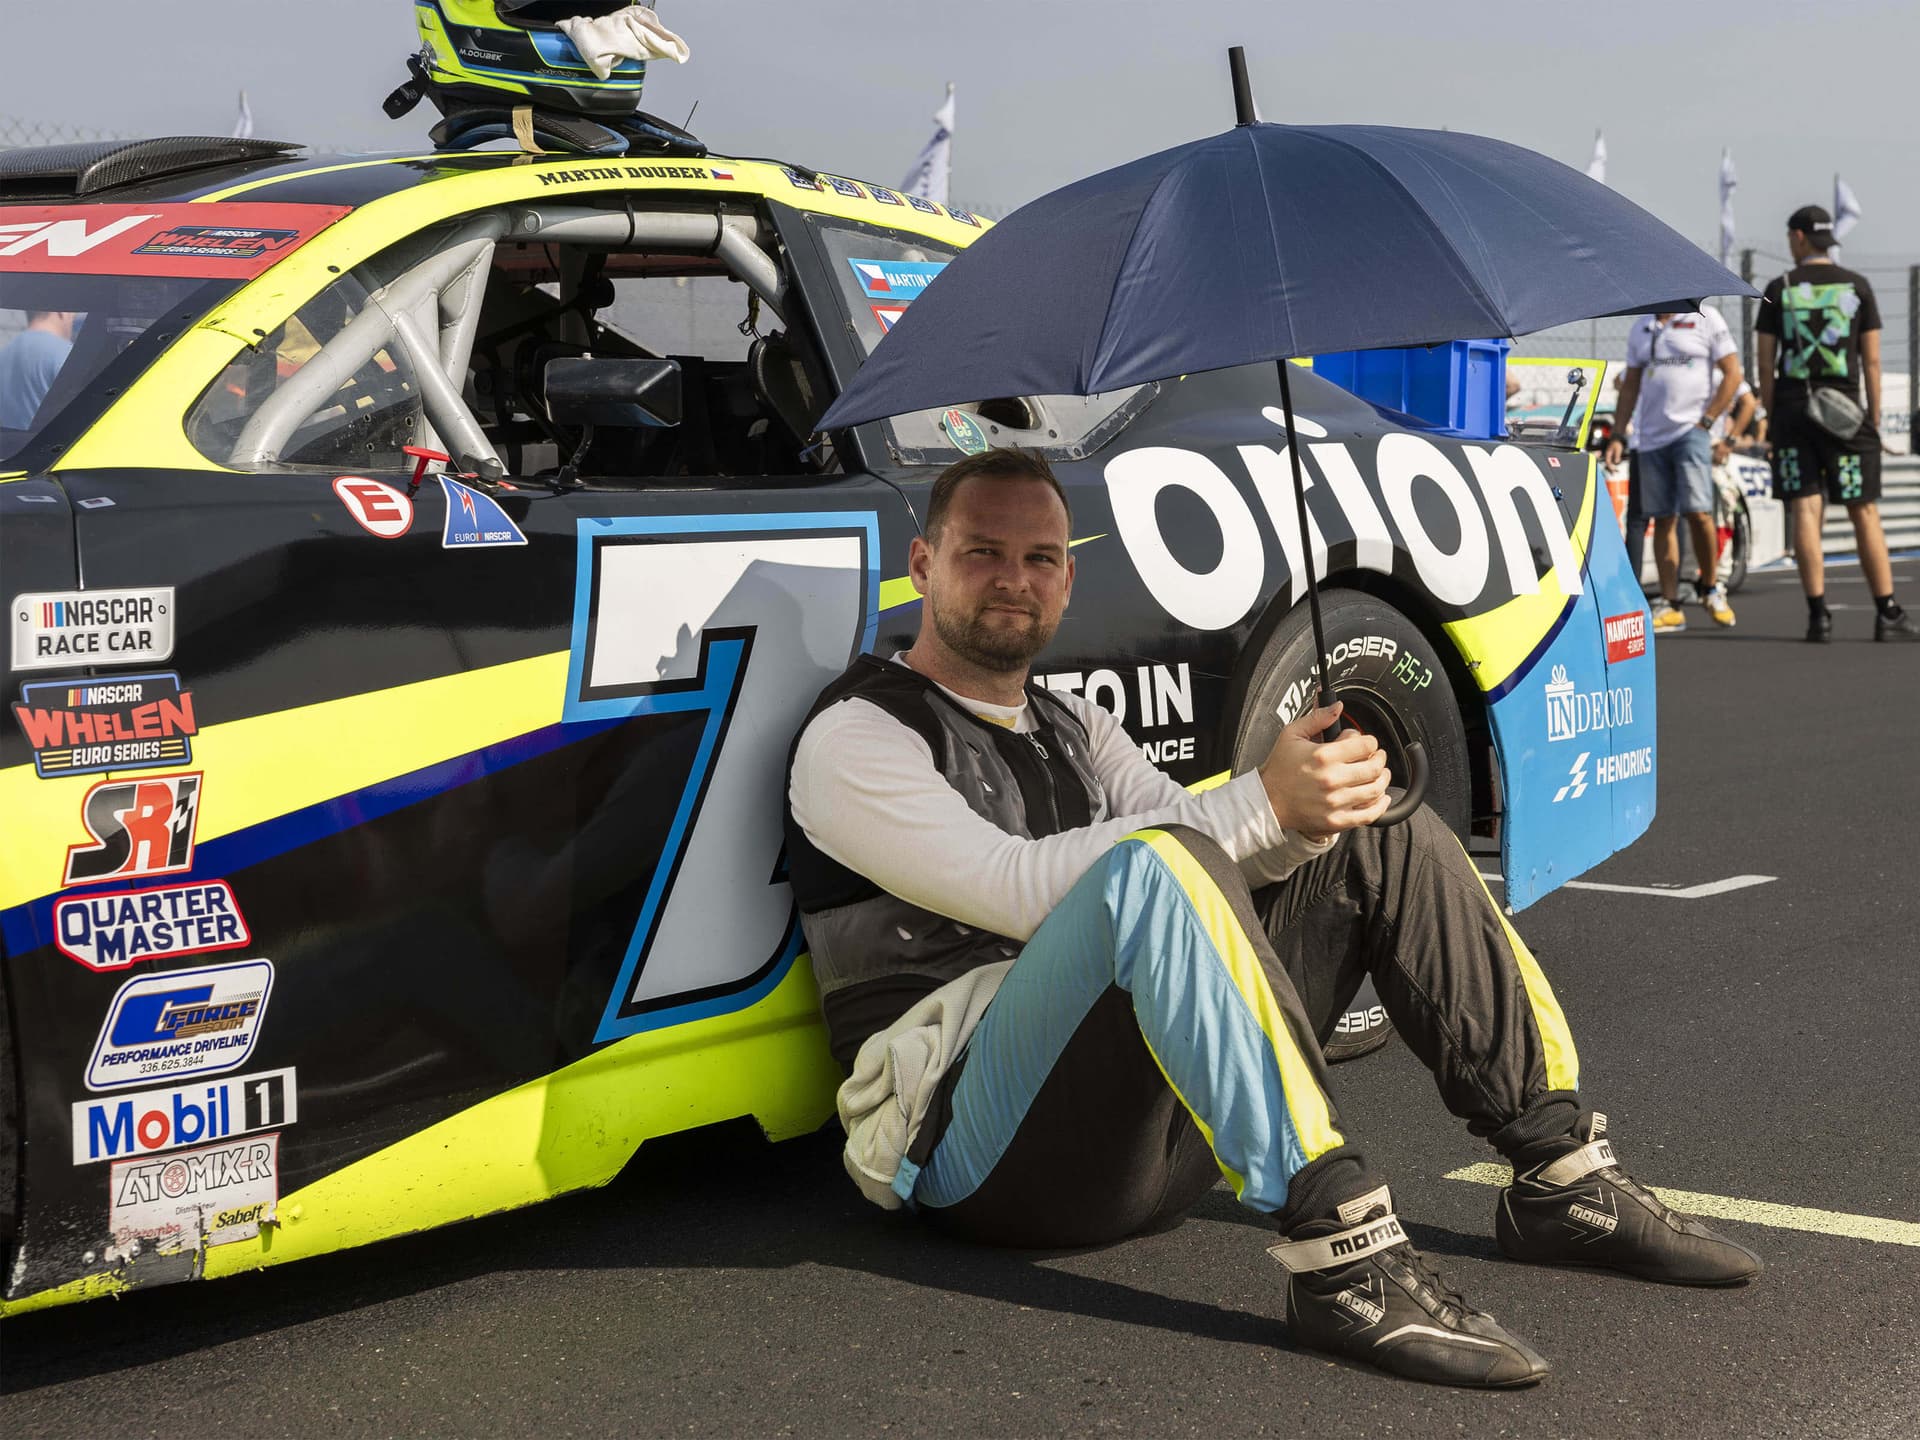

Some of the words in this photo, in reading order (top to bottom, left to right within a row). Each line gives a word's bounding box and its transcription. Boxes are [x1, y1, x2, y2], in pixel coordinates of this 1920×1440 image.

[537, 167, 623, 187] MARTIN
[627, 166, 708, 180] DOUBEK
[149, 233, 295, 249] WHELEN
[885, 272, 927, 287] MARTIN
[344, 484, 402, 522] E
[1104, 407, 1584, 630] orion
[455, 532, 476, 543] EURO
[484, 531, 512, 542] NASCAR
[65, 598, 154, 627] NASCAR
[38, 633, 99, 656] RACE
[108, 630, 152, 651] CAR
[1606, 615, 1645, 643] NANOTECH
[88, 685, 142, 705] NASCAR
[1137, 662, 1194, 728] IN
[16, 692, 196, 749] WHELEN
[72, 747, 111, 766] EURO
[114, 742, 160, 761] SERIES
[1596, 747, 1652, 785] HENDRIKS
[61, 886, 229, 946] QUARTER
[96, 913, 240, 964] MASTER
[101, 1043, 192, 1067] PERFORMANCE
[194, 1033, 249, 1053] DRIVELINE
[140, 1055, 204, 1074] 336.625.3844
[88, 1085, 229, 1159] Mobil
[255, 1082, 272, 1126] 1
[216, 1205, 264, 1229] Sabelt
